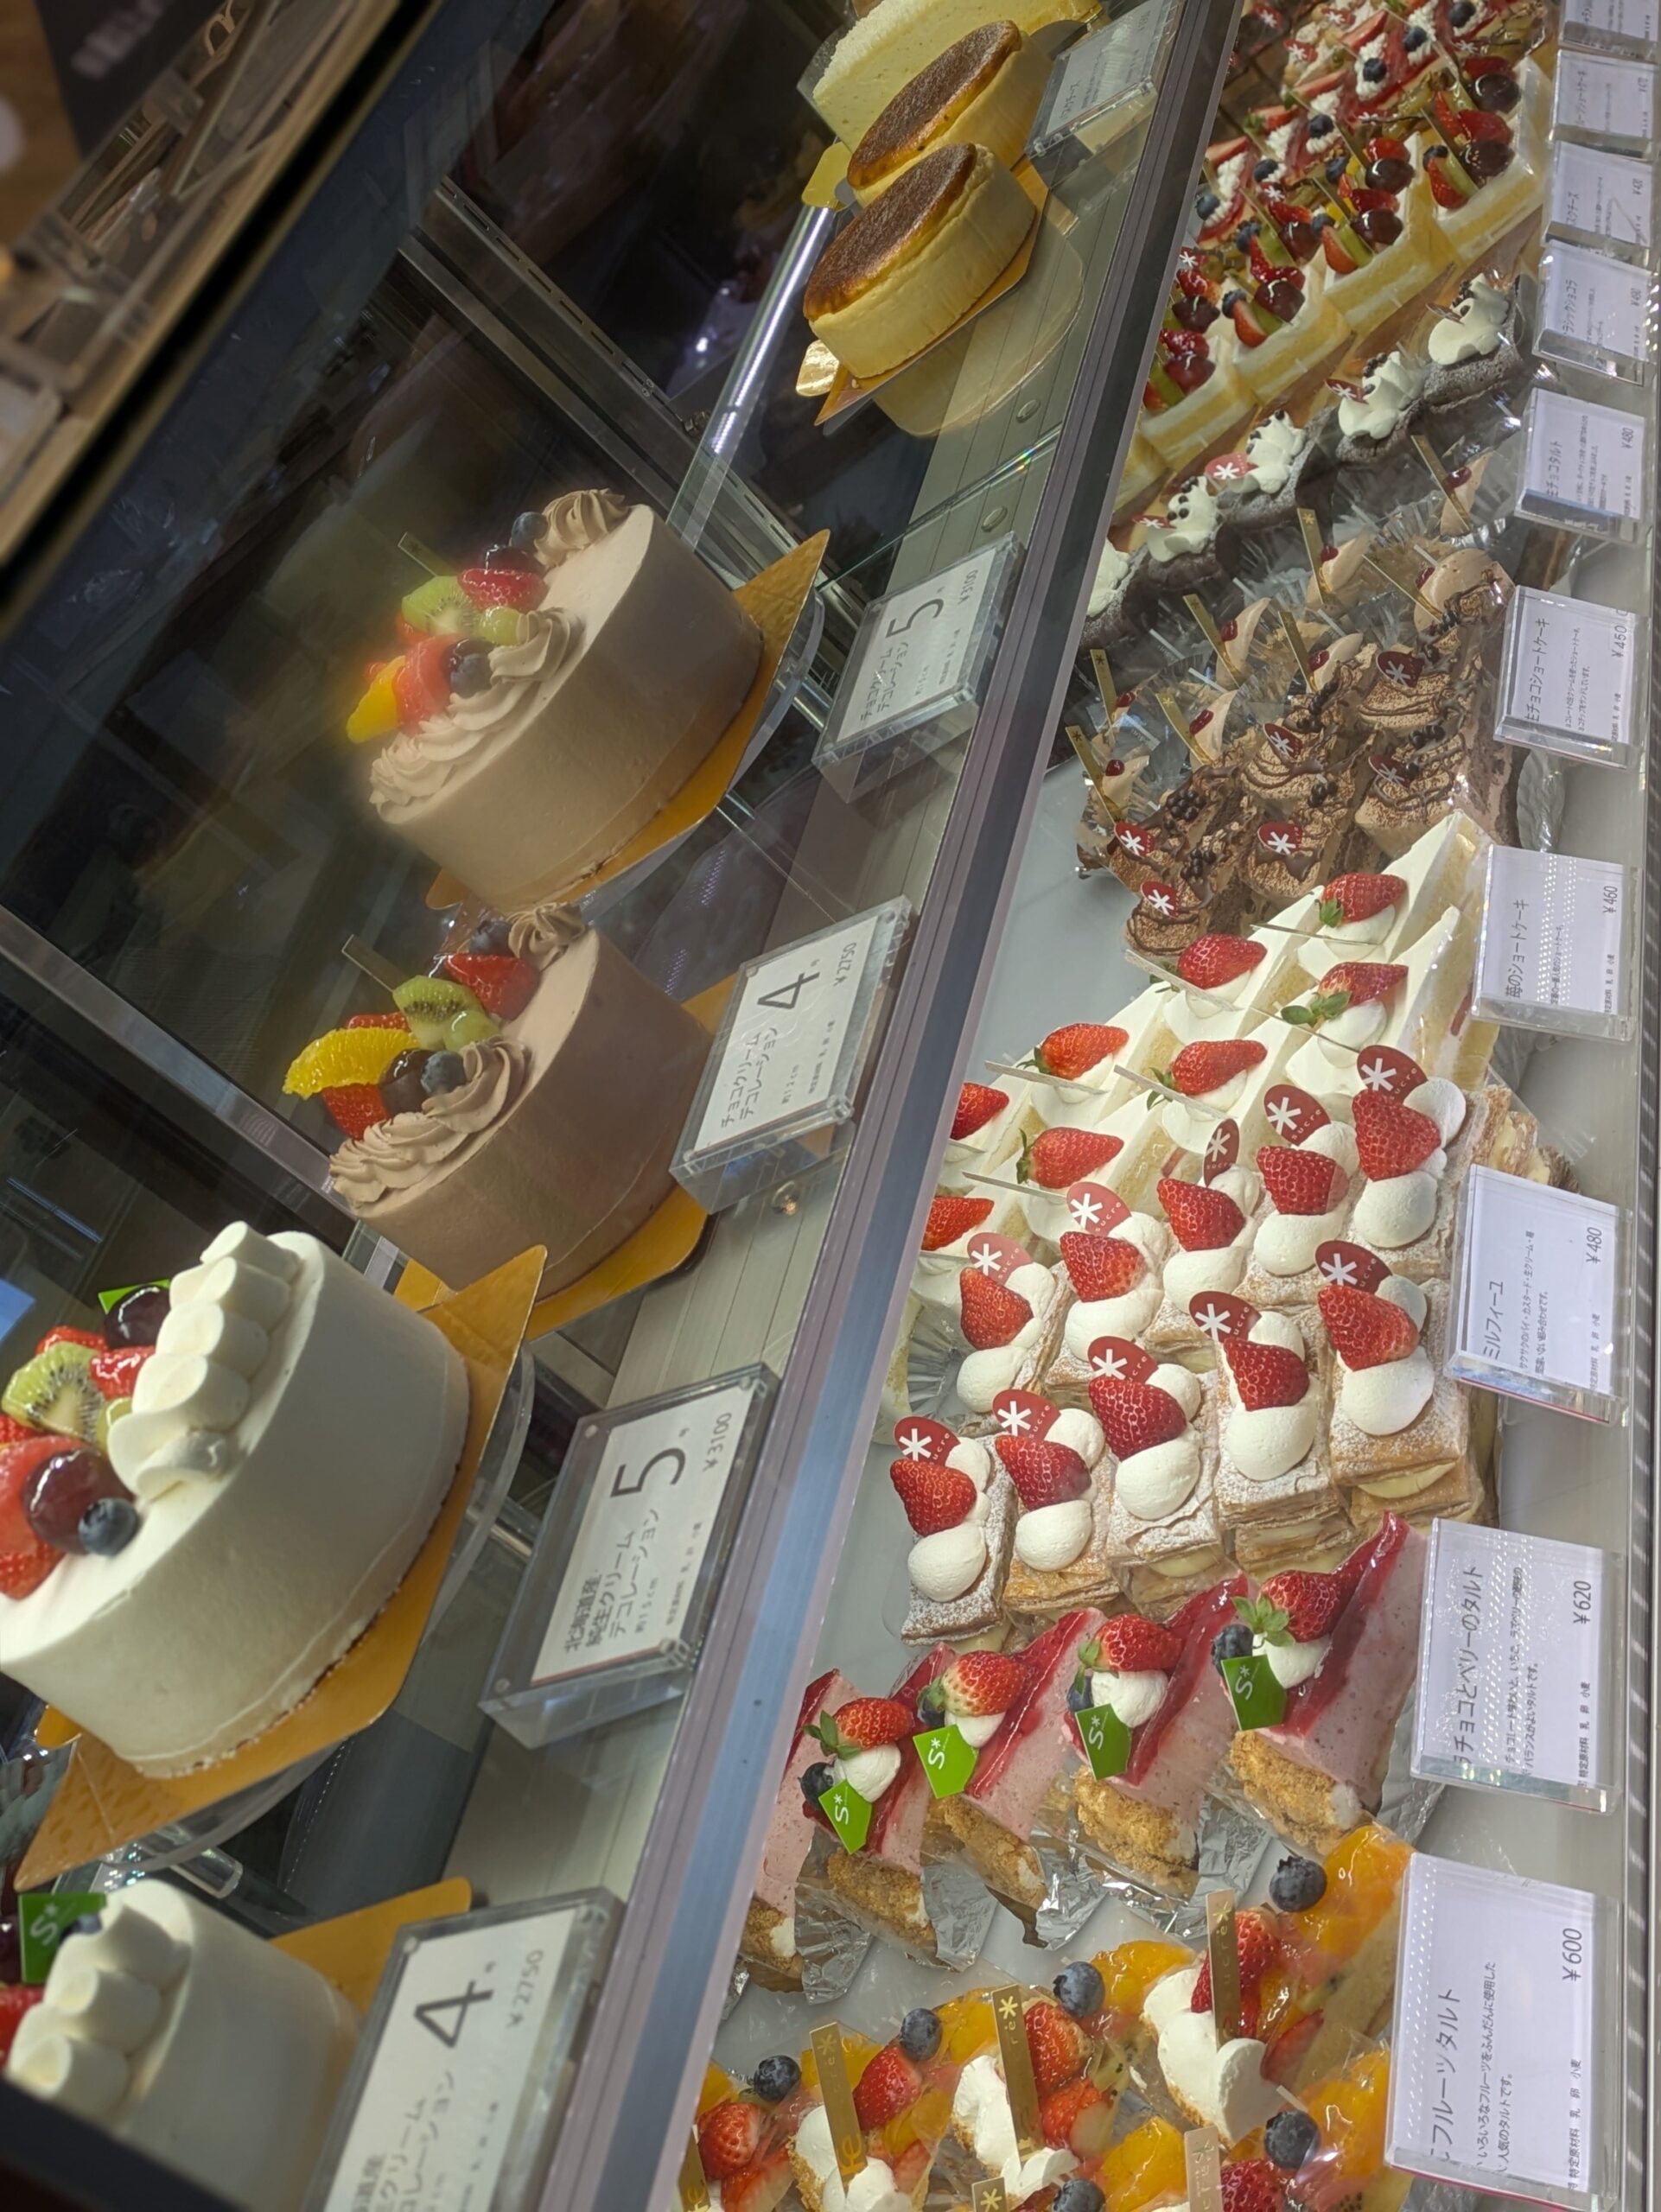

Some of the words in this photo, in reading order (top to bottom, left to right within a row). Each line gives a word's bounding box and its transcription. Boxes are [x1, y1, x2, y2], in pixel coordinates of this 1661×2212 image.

[1562, 279, 1579, 335] ラシックショコラ
[886, 598, 945, 638] 5
[1612, 625, 1627, 658] ¥450
[1602, 886, 1618, 914] ¥460
[1505, 899, 1529, 998] 苺のショートケーキ
[757, 972, 820, 1009] 4
[721, 1032, 760, 1128] チョコクリーム
[740, 1027, 777, 1120] デコレーション
[1586, 1227, 1602, 1264] ¥480
[1483, 1281, 1504, 1361] ミルフィーユ
[703, 1412, 732, 1471] ¥3100
[610, 1447, 686, 1498] 5
[586, 1530, 635, 1647] 純生クリーム
[608, 1510, 659, 1637] デコレーション
[1573, 1580, 1592, 1624] ¥620
[565, 1573, 602, 1654] 北海道産
[1454, 1567, 1483, 1752] チョコとベリーのタルト
[1562, 1928, 1582, 1981] ¥600
[413, 1980, 494, 2048] 4
[1432, 1989, 1461, 2145] フルーツタルト
[1477, 1961, 1496, 2158] いろいろなフルーツをふんだんに使用した
[1570, 2059, 1581, 2080] 小麦
[1497, 2074, 1513, 2164] 人気のタルトです。
[1569, 2088, 1581, 2099] 卵
[1569, 2108, 1581, 2118] 乳
[1569, 2128, 1581, 2178] 特定原材料
